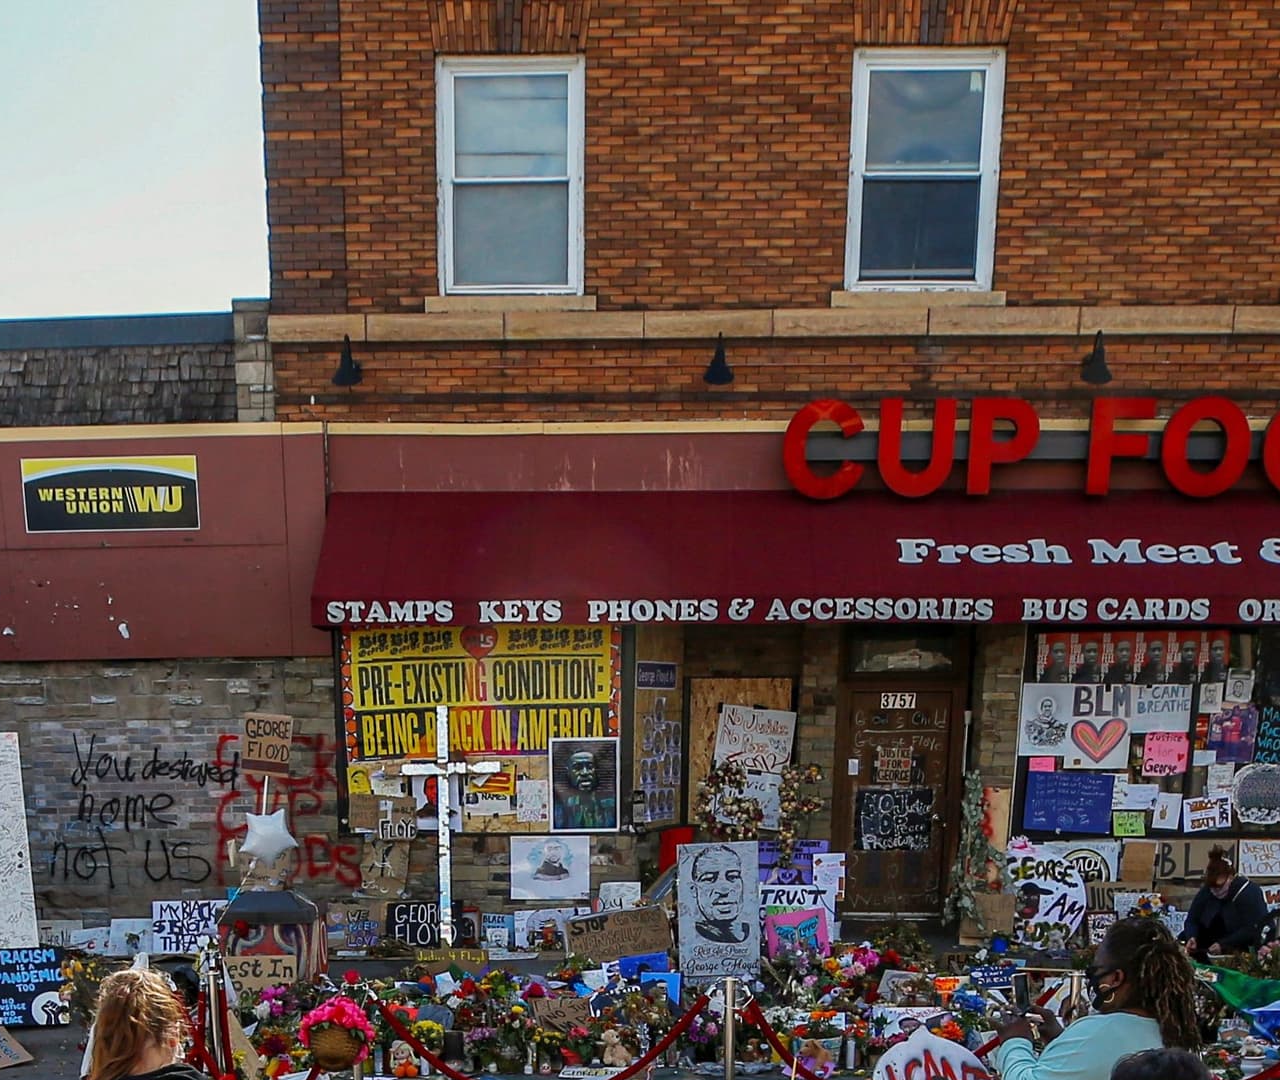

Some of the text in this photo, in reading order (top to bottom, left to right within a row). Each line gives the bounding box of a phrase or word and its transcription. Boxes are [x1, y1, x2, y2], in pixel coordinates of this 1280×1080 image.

[782, 398, 1040, 499] CUP
[38, 487, 124, 501] WESTERN
[132, 486, 182, 513] WU
[66, 501, 124, 514] UNION
[896, 538, 1073, 566] Fresh
[1088, 539, 1239, 566] Meat
[326, 600, 453, 624] STAMPS
[478, 599, 561, 624] KEYS
[587, 599, 718, 622] PHONES
[728, 599, 755, 621] &
[765, 597, 993, 623] ACCESSORIES
[1022, 598, 1088, 622] BUS
[1097, 598, 1210, 622] CARDS
[358, 659, 604, 706] PRE-EXISTING CONDITION:
[882, 693, 916, 708] 3757
[1073, 685, 1131, 717] BLM
[1138, 686, 1187, 699] I CANT
[1137, 700, 1190, 714] BREATHE
[726, 708, 743, 726] No
[246, 719, 291, 739] GEORGE
[362, 712, 419, 757] BEING
[425, 708, 485, 753] BACK
[490, 708, 512, 751] IN
[722, 726, 739, 745] No
[72, 733, 239, 790] You destroyed
[879, 748, 912, 759] JUSTICE
[887, 760, 902, 768] FOR
[1144, 759, 1177, 774] George
[877, 770, 911, 781] GEORGE
[481, 792, 508, 801] NAMES
[79, 785, 177, 831] home
[380, 819, 417, 839] FLOYD
[51, 827, 125, 888] not
[1008, 857, 1079, 888] GEORGE
[761, 889, 827, 905] TRUST
[160, 900, 216, 921] MY BLACK
[347, 910, 370, 922] WE
[395, 903, 456, 922] GEOR
[1044, 892, 1085, 924] AM
[483, 914, 505, 923] BLACK
[571, 918, 608, 936] STOP
[160, 934, 202, 952] THREA
[346, 936, 378, 947] LOVE
[0, 950, 55, 965] RACISM
[685, 957, 758, 974] George Floyd
[230, 960, 293, 978] est In
[16, 984, 35, 992] TOO
[0, 1016, 23, 1024] PEACE
